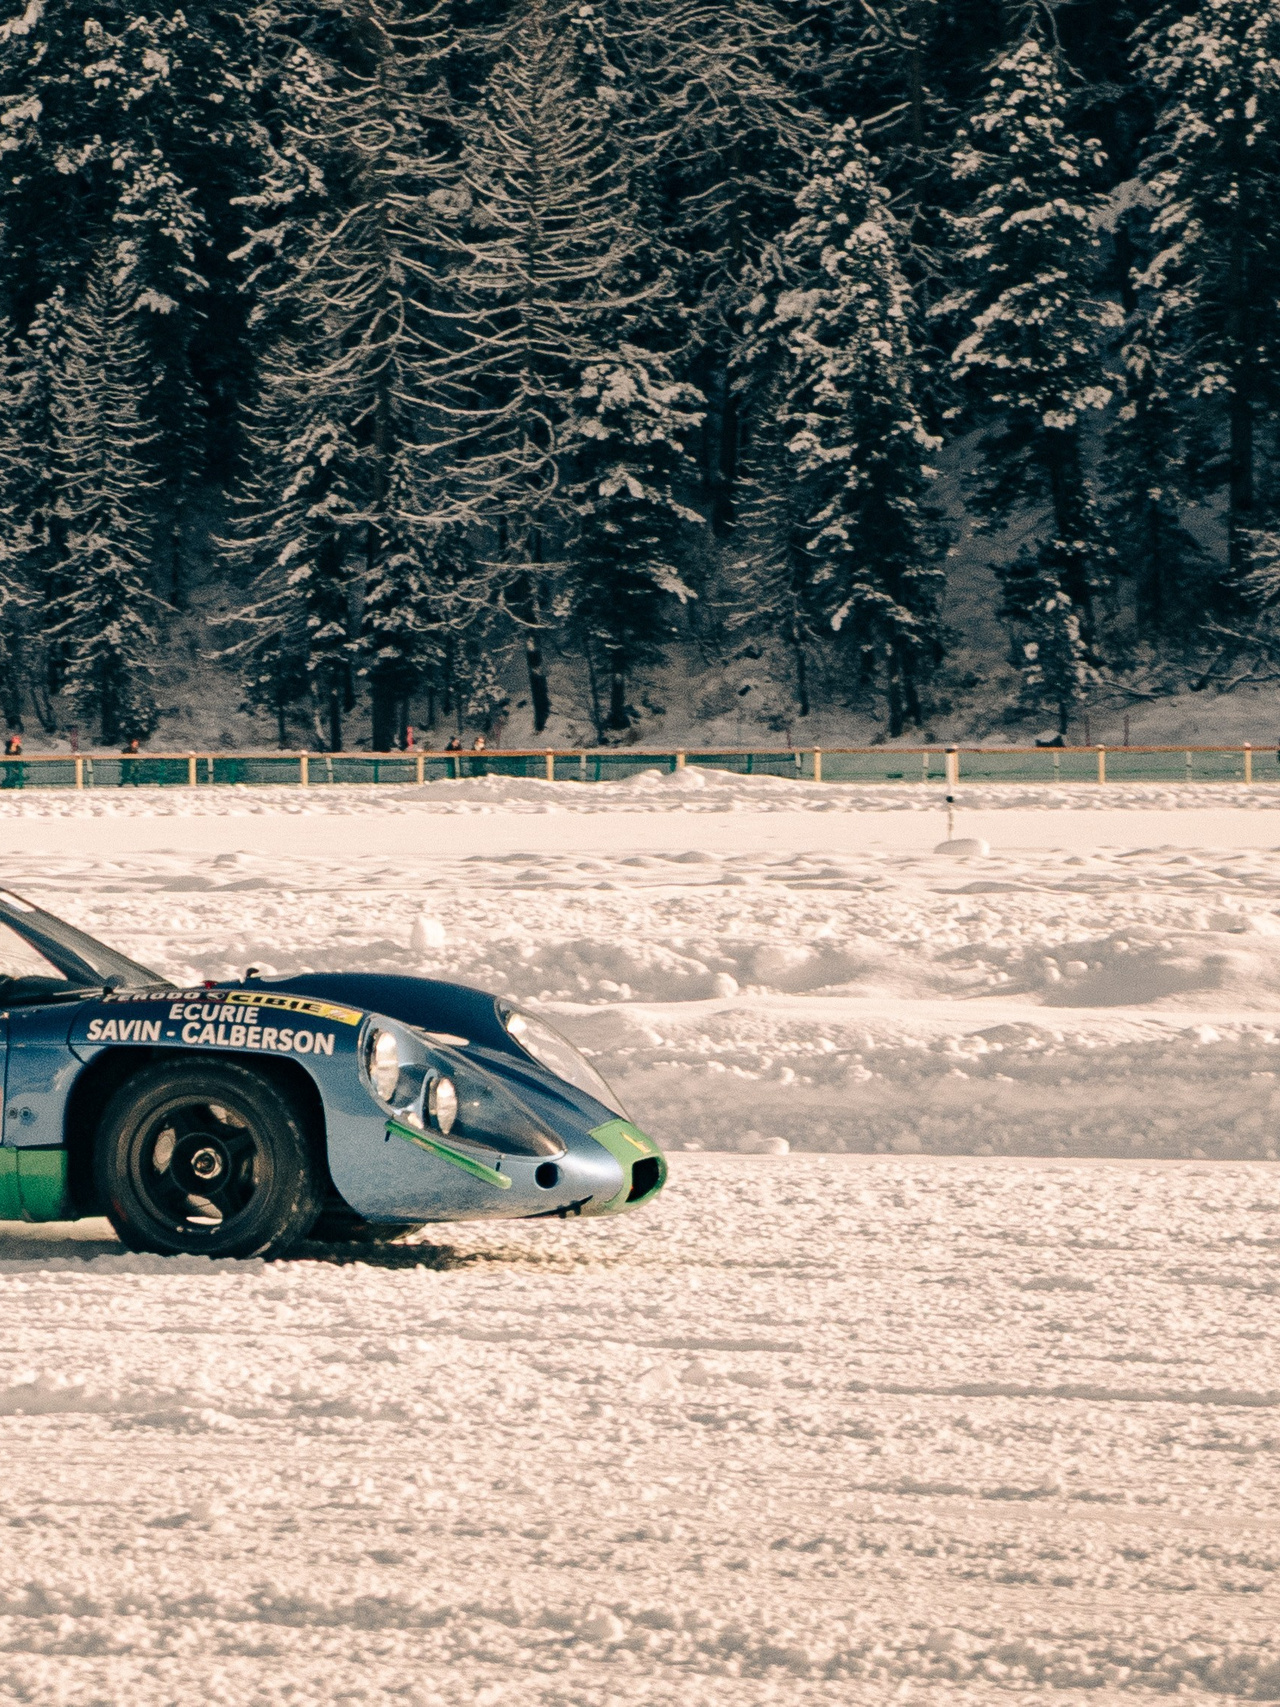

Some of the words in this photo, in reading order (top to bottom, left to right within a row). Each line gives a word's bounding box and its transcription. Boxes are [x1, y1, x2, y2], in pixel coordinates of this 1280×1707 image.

[169, 1003, 259, 1024] ECURIE
[87, 1019, 161, 1042] SAVIN
[181, 1022, 335, 1056] CALBERSON
